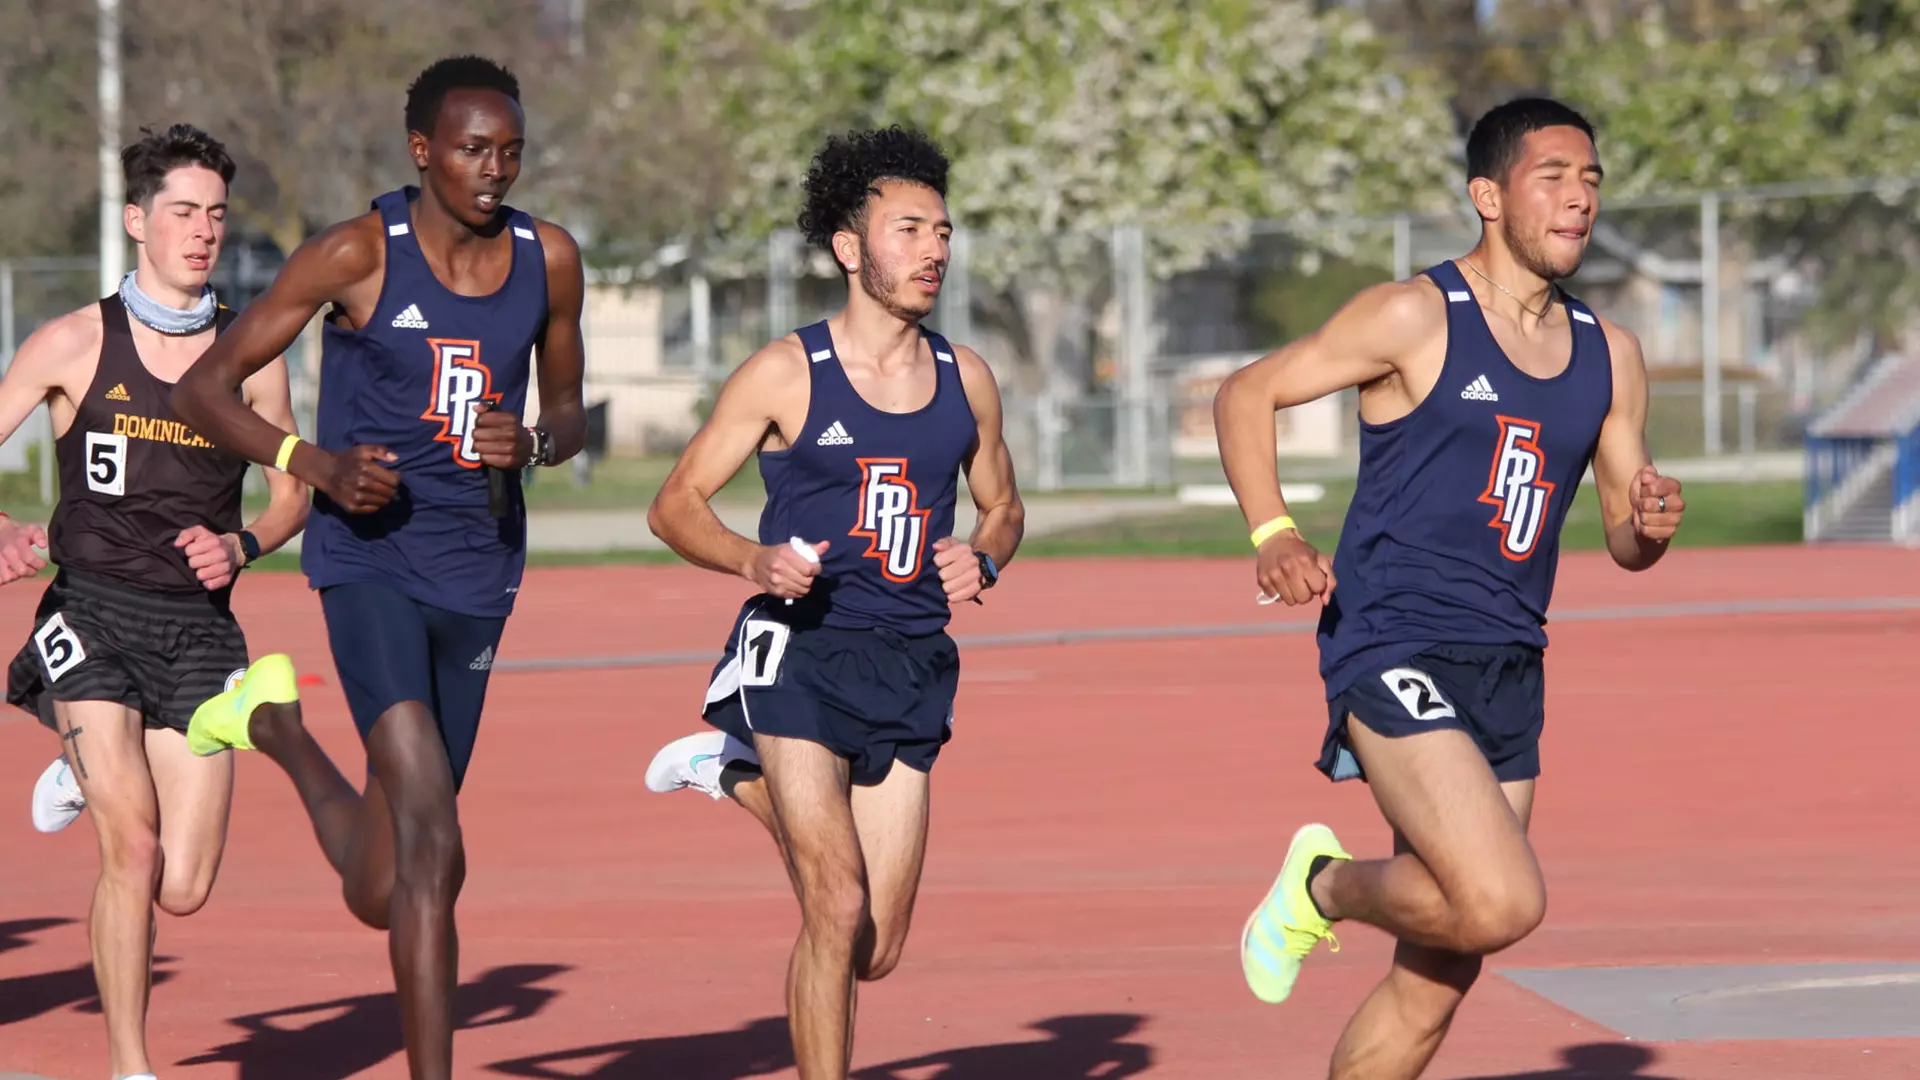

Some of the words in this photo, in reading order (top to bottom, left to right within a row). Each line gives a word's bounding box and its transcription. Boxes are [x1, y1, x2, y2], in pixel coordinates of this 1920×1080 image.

[392, 317, 428, 329] adidas
[1461, 388, 1498, 402] adidas
[113, 413, 215, 448] DOMINICA
[817, 434, 854, 445] adidas
[89, 442, 118, 486] 5
[1492, 423, 1546, 554] FPU
[863, 463, 923, 577] FPU
[43, 625, 74, 669] 5
[749, 629, 775, 678] 1
[1397, 677, 1449, 717] 2
